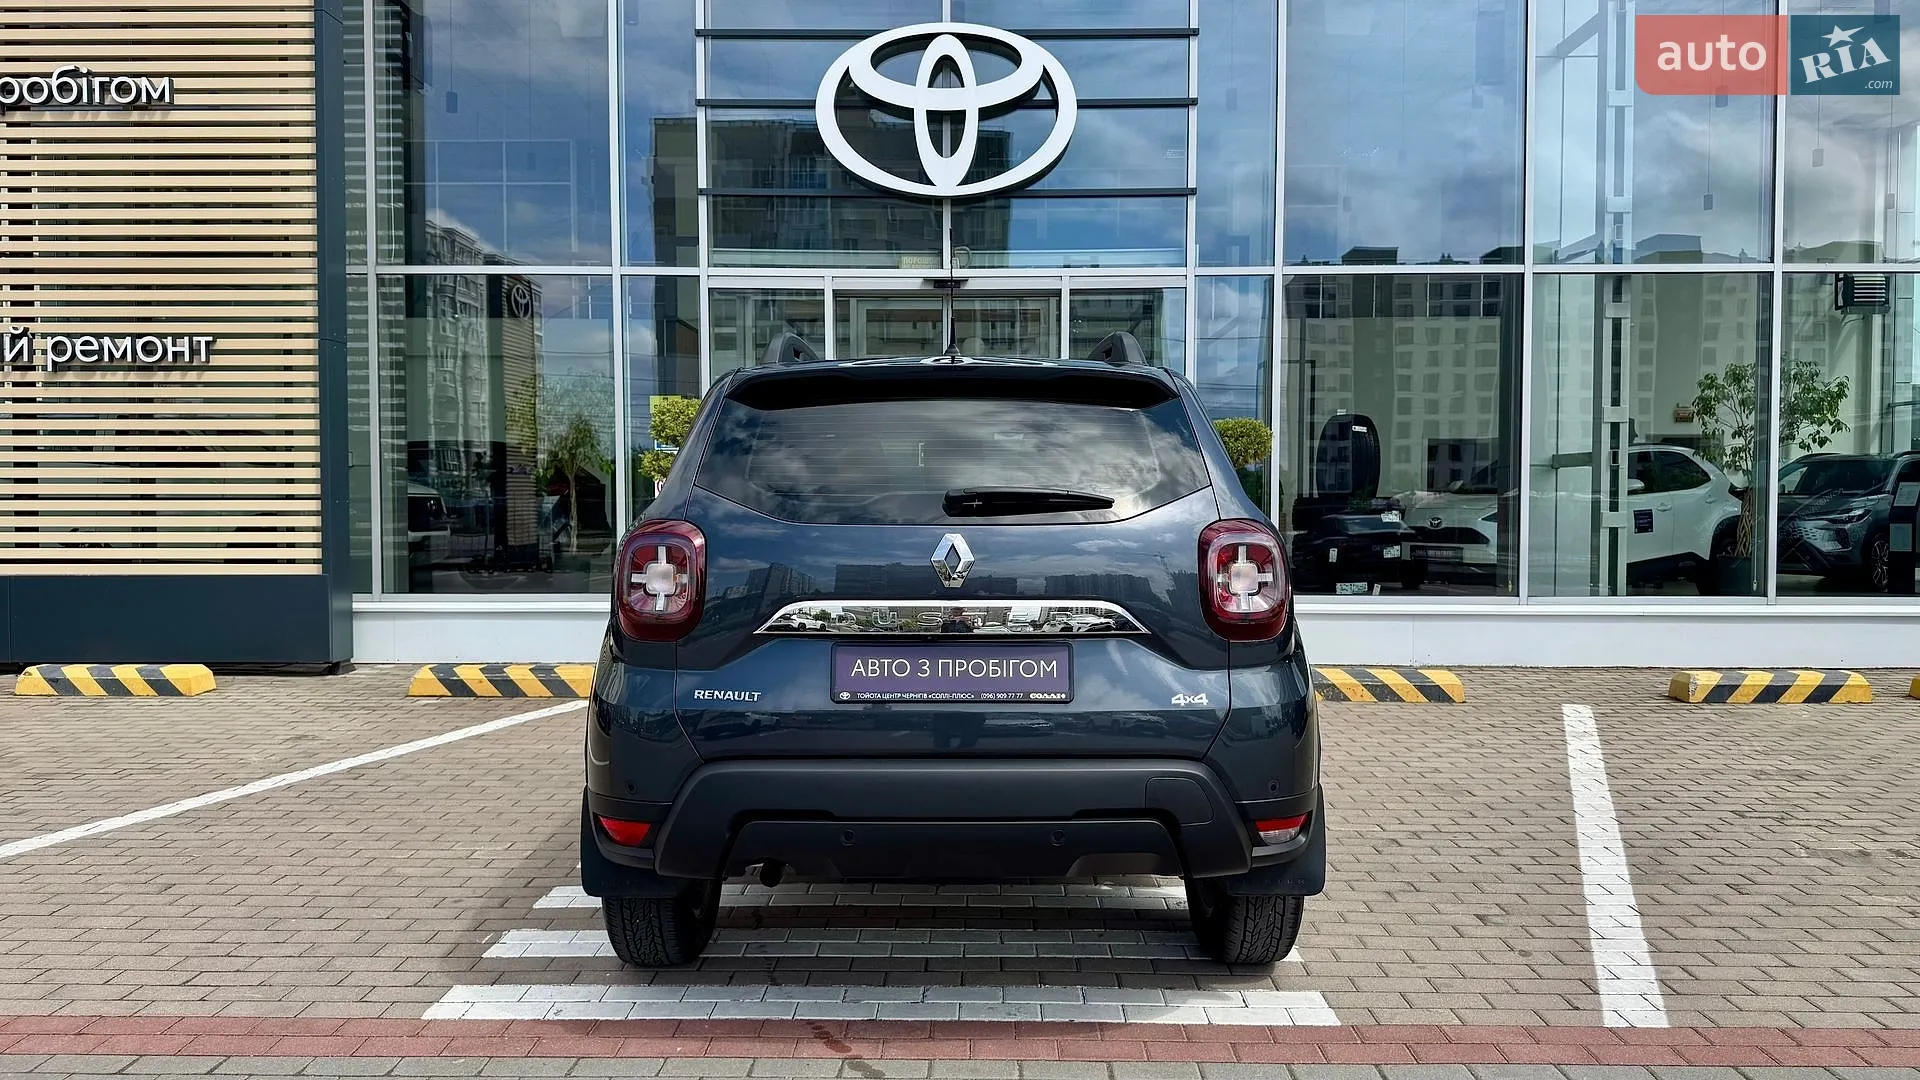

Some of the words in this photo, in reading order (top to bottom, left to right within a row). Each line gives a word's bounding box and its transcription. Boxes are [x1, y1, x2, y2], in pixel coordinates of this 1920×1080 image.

[47, 335, 213, 371] ремонт
[851, 659, 910, 677] АВТО
[938, 659, 1057, 678] ПРОБІГОМ
[694, 689, 762, 702] RENAULT
[857, 691, 881, 699] ТОЙОТА
[882, 692, 901, 700] ЦЕНТР
[980, 692, 995, 700] (096)
